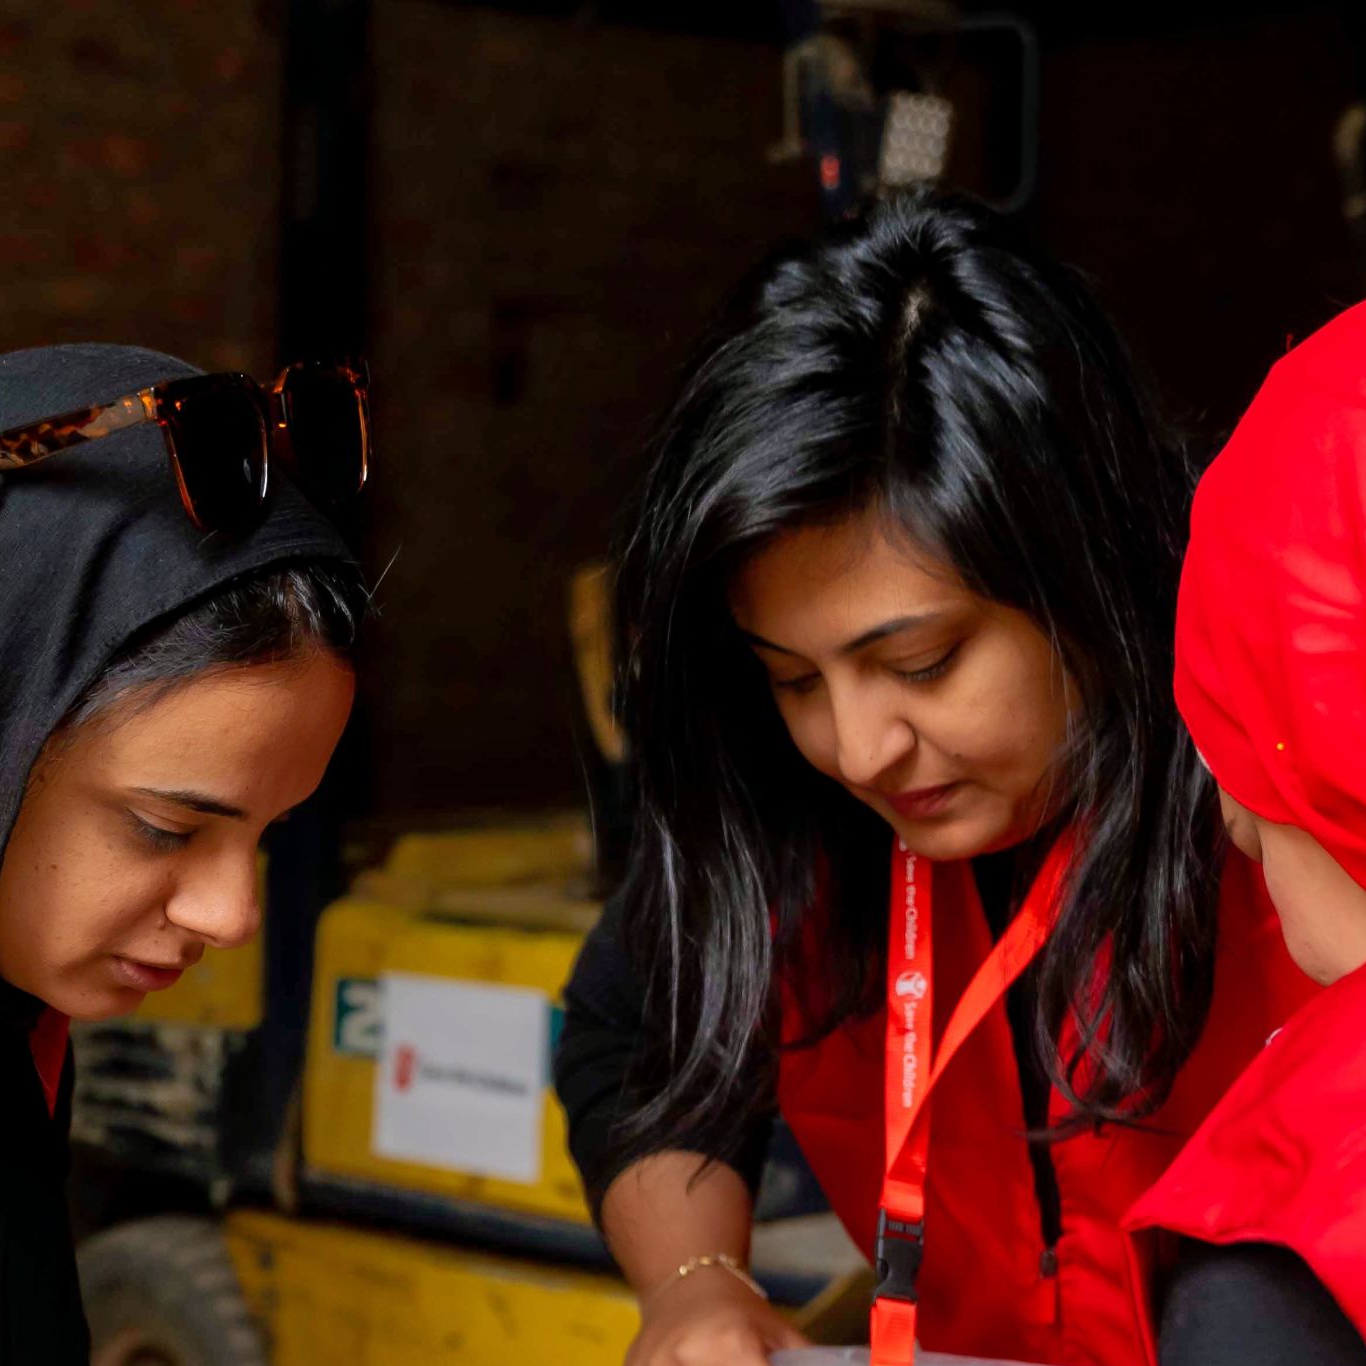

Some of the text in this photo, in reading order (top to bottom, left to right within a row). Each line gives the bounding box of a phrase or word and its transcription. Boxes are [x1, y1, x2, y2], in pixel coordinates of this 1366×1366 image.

[901, 1001, 917, 1108] Save the Children
